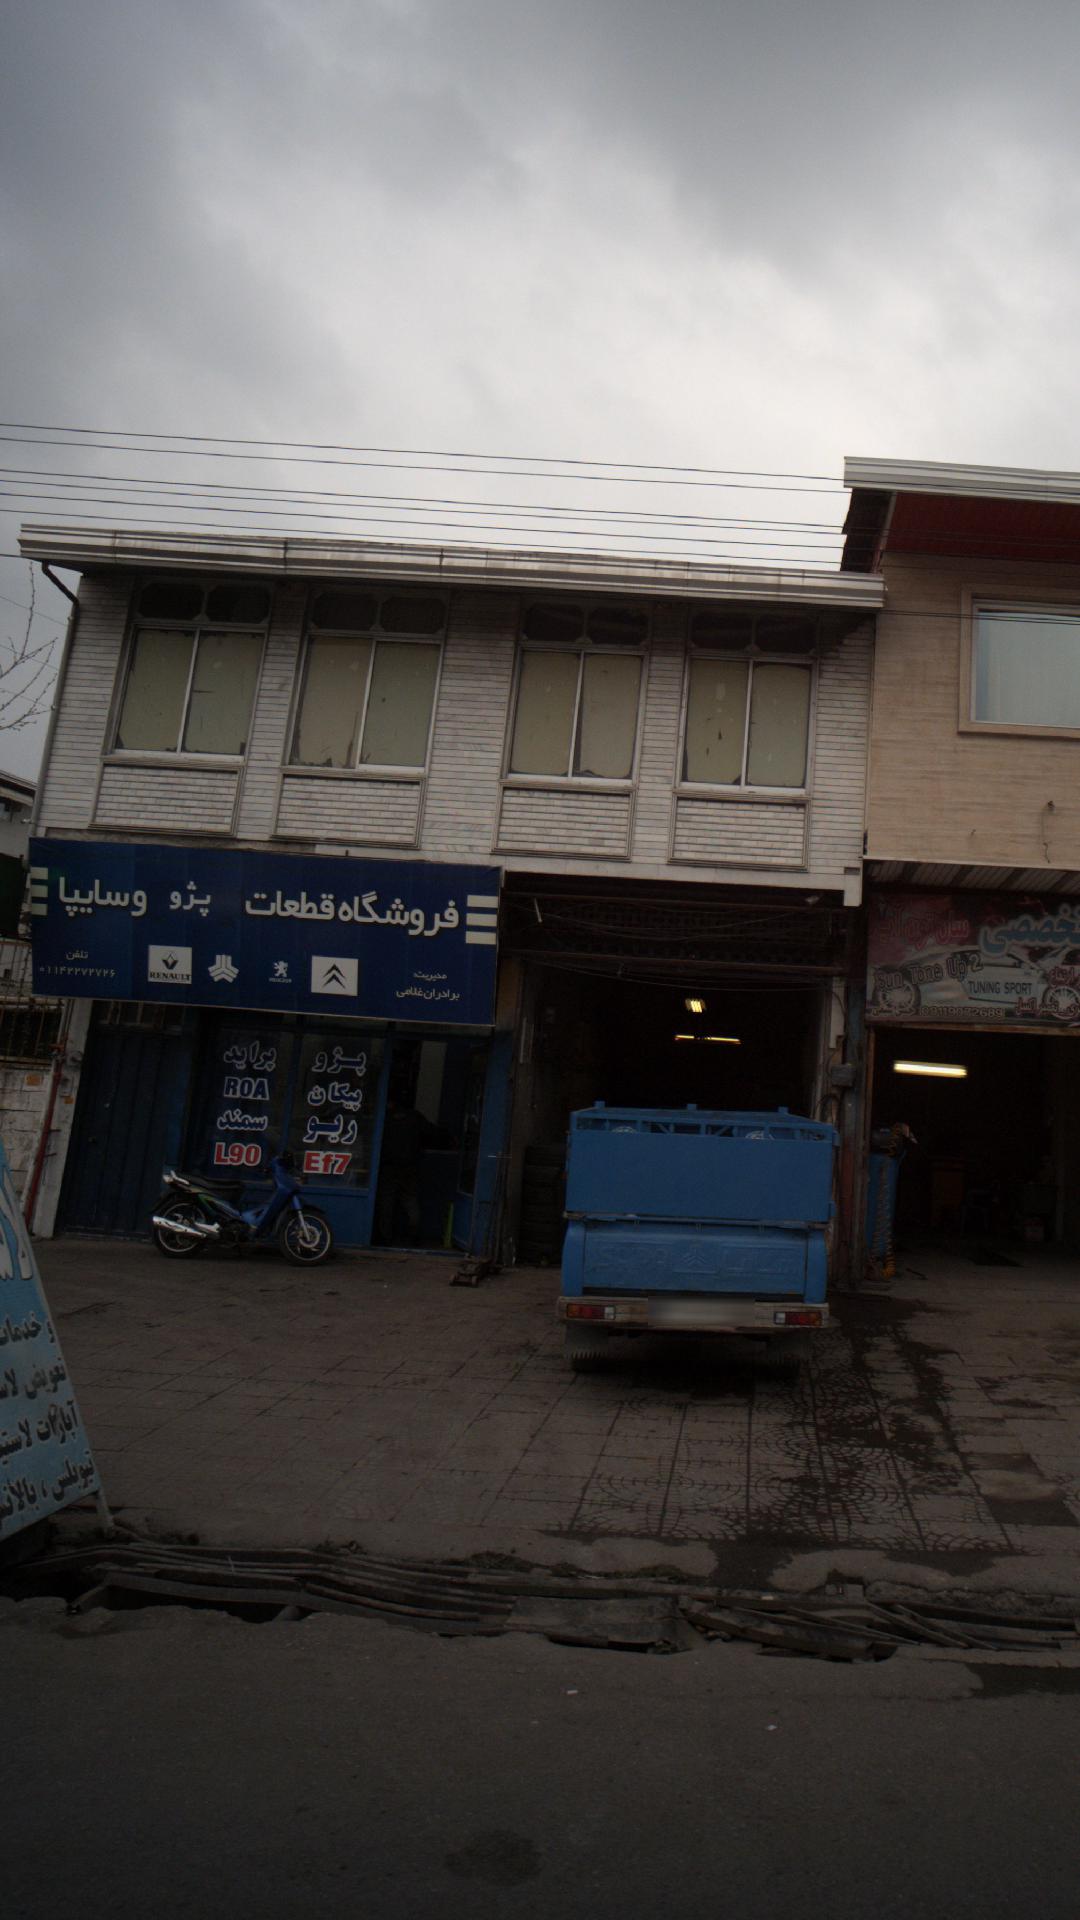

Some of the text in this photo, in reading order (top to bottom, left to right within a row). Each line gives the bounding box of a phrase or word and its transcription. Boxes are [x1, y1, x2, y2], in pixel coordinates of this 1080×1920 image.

[168, 880, 211, 917] پژو
[244, 890, 336, 921] قطعات
[337, 890, 460, 937] فروشگاه
[65, 950, 89, 961] تلفن
[149, 971, 192, 983] RENAULT
[412, 970, 448, 982] مدیریت
[967, 980, 1033, 996] TUNING SPORT
[423, 988, 461, 1001] برادران
[223, 1041, 277, 1071] پراید
[311, 1046, 366, 1077] پژو
[223, 1076, 270, 1101] ROA
[307, 1082, 363, 1111] پیکان
[217, 1108, 268, 1131] سمند
[302, 1114, 358, 1144] ریو
[213, 1142, 262, 1167] L90
